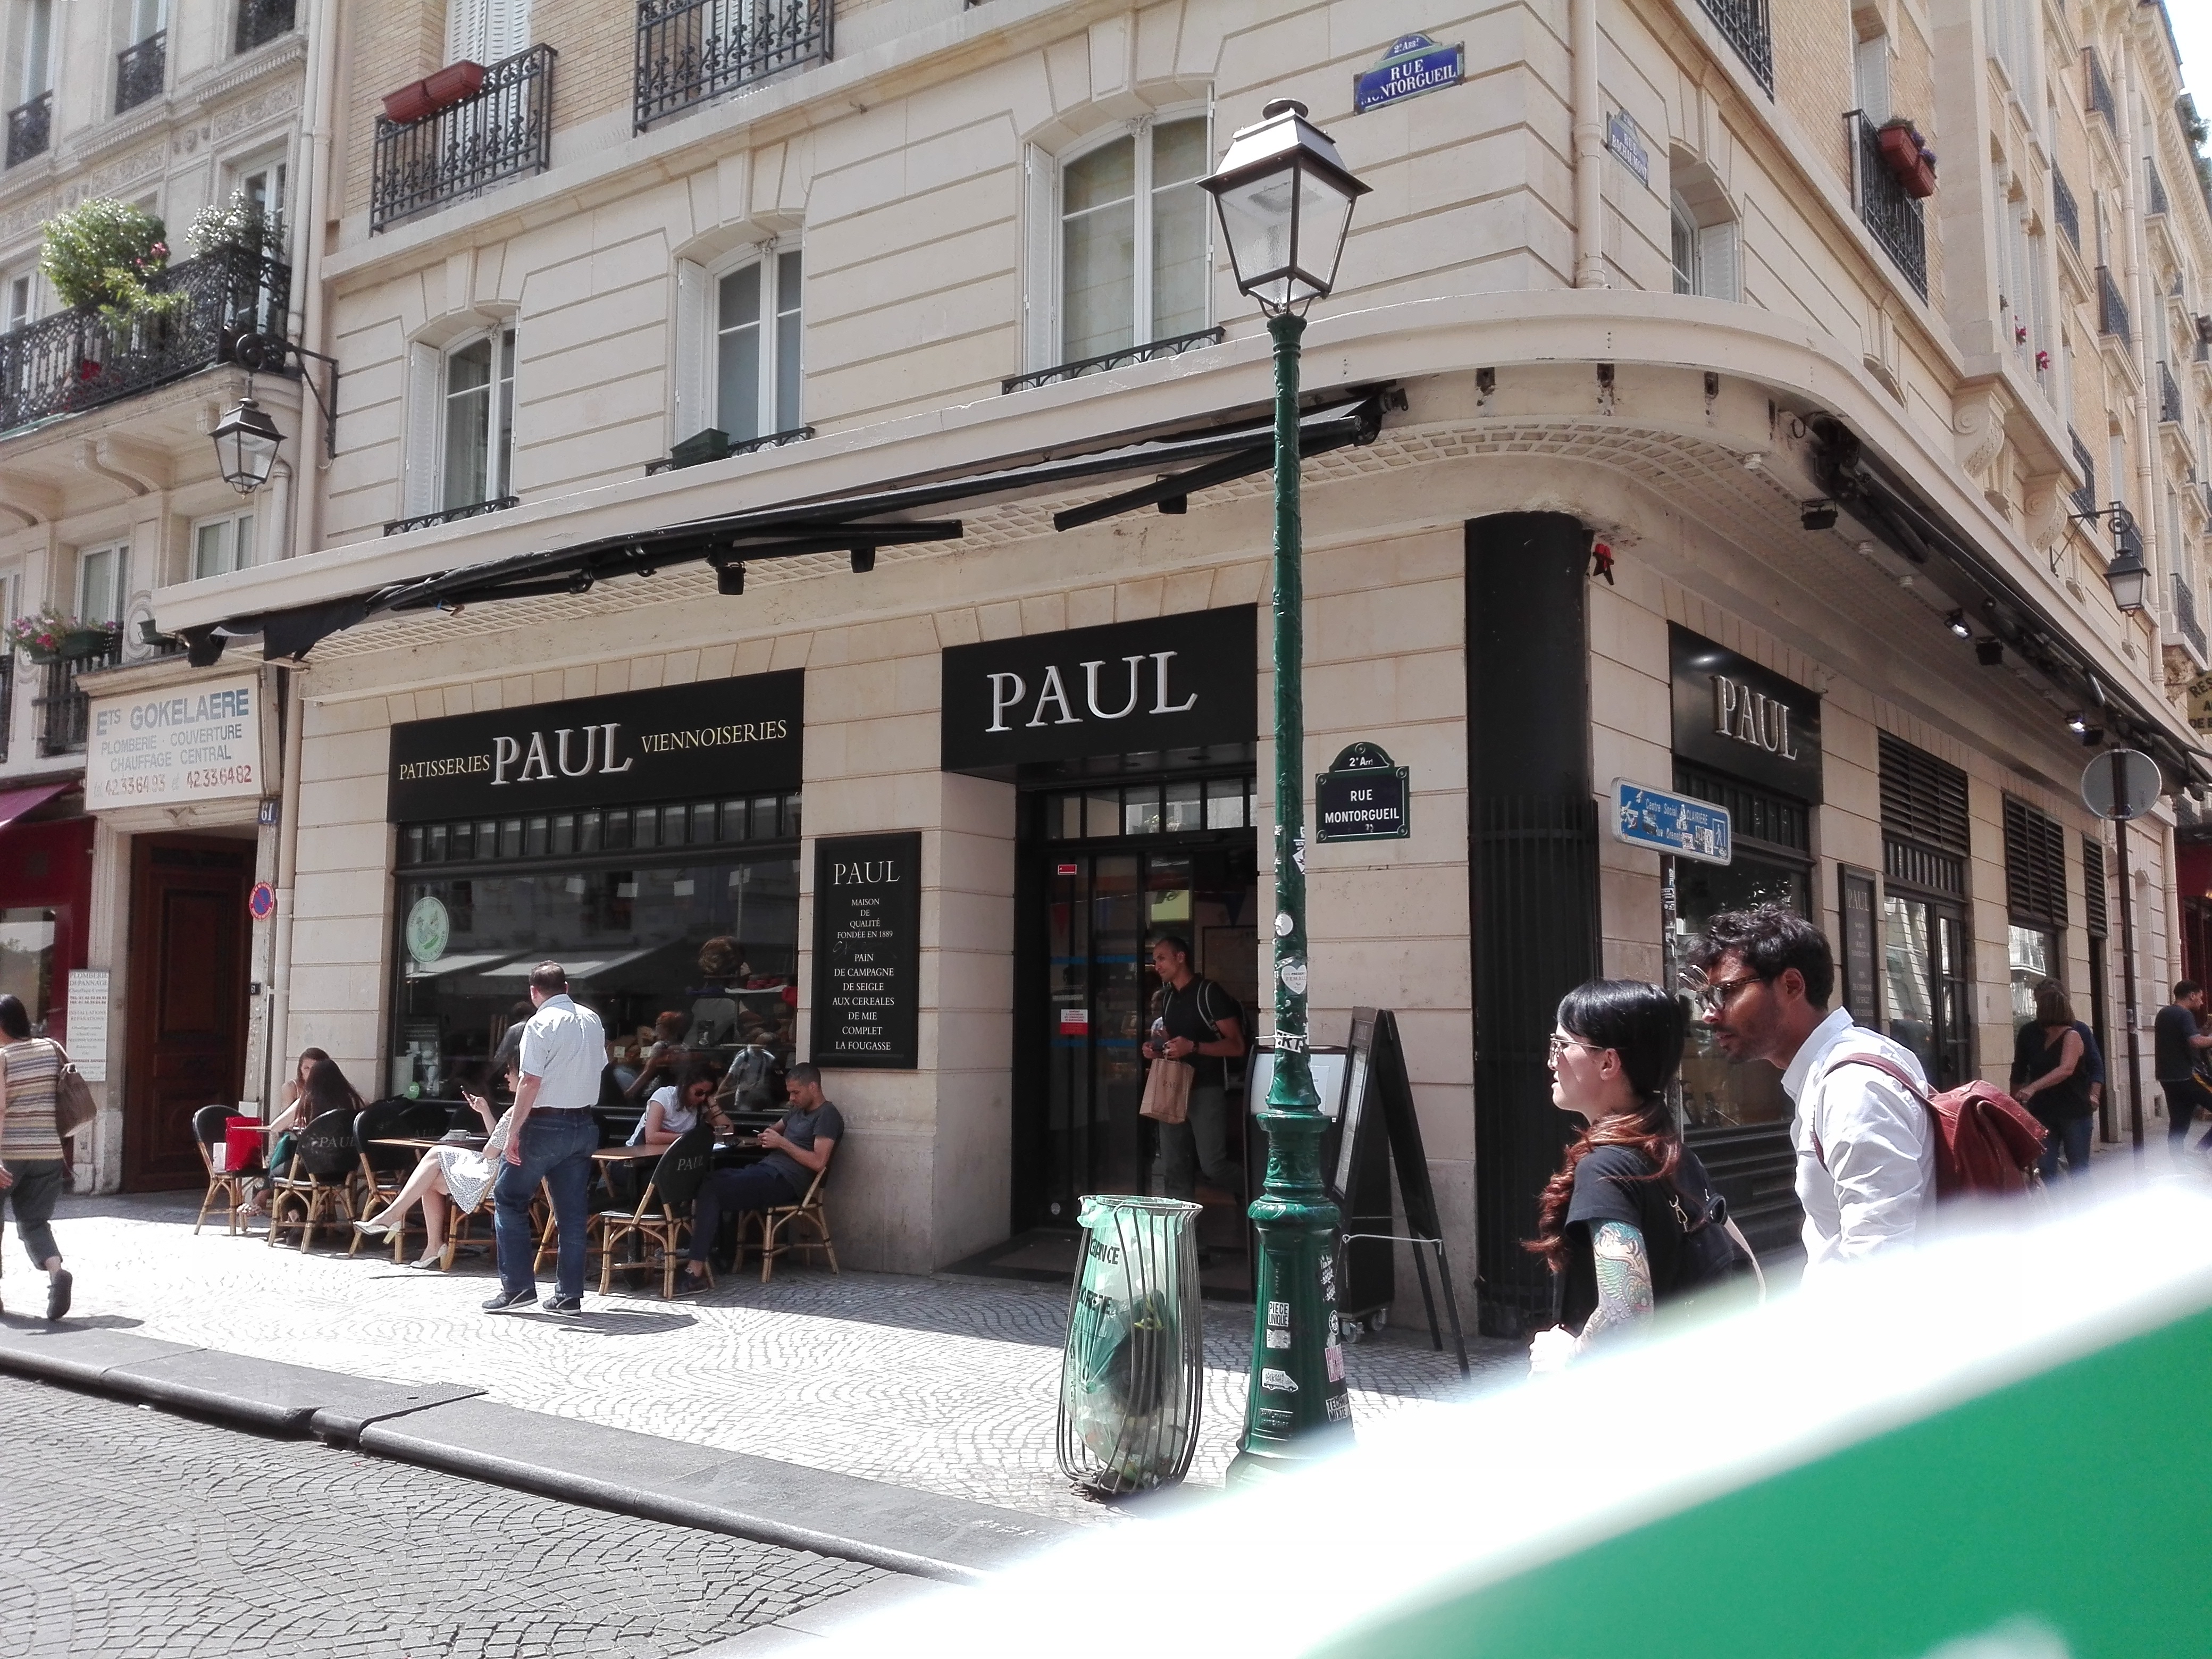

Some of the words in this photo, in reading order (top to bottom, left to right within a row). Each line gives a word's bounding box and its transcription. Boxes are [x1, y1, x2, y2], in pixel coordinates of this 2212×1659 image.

[1390, 59, 1423, 80] RUE
[1360, 64, 1457, 105] NTORGUEIL
[985, 651, 1198, 732] PAUL
[130, 689, 249, 731] GOKELAERE
[1714, 675, 1797, 760] PAUL
[101, 735, 157, 755] PLOMBERIE
[170, 723, 242, 747] COUVERTURE
[111, 751, 171, 772] CHAUFFAGE
[180, 744, 231, 765] CENTRAL
[399, 754, 490, 780] PATISSERIES
[490, 723, 633, 785] PAUL
[641, 719, 787, 753] VIENNOISERIES
[1350, 789, 1373, 802] RUE
[261, 803, 273, 821] 61
[1645, 798, 1661, 812] Centre
[1664, 803, 1677, 817] Social
[1325, 808, 1400, 824] MONTORGUEIL
[833, 860, 900, 885] PAUL
[1847, 889, 1870, 911] PAUL
[850, 918, 881, 928] QUALITÉ
[837, 929, 866, 939] FONDÉE
[854, 953, 874, 962] PAIN
[834, 968, 845, 976] DE
[847, 968, 894, 976] CAMPAGNE
[856, 983, 884, 991] SEIGLE
[832, 997, 850, 1006] AUX
[852, 997, 894, 1006] CEREALES
[848, 1011, 860, 1020] DE
[861, 1011, 877, 1020] MIE
[842, 1026, 883, 1035] COMPLET
[835, 1041, 845, 1050] LA
[848, 1041, 891, 1051] FOUGASSE
[1269, 1303, 1288, 1315] PIECE
[1269, 1314, 1288, 1326] UNIQUE
